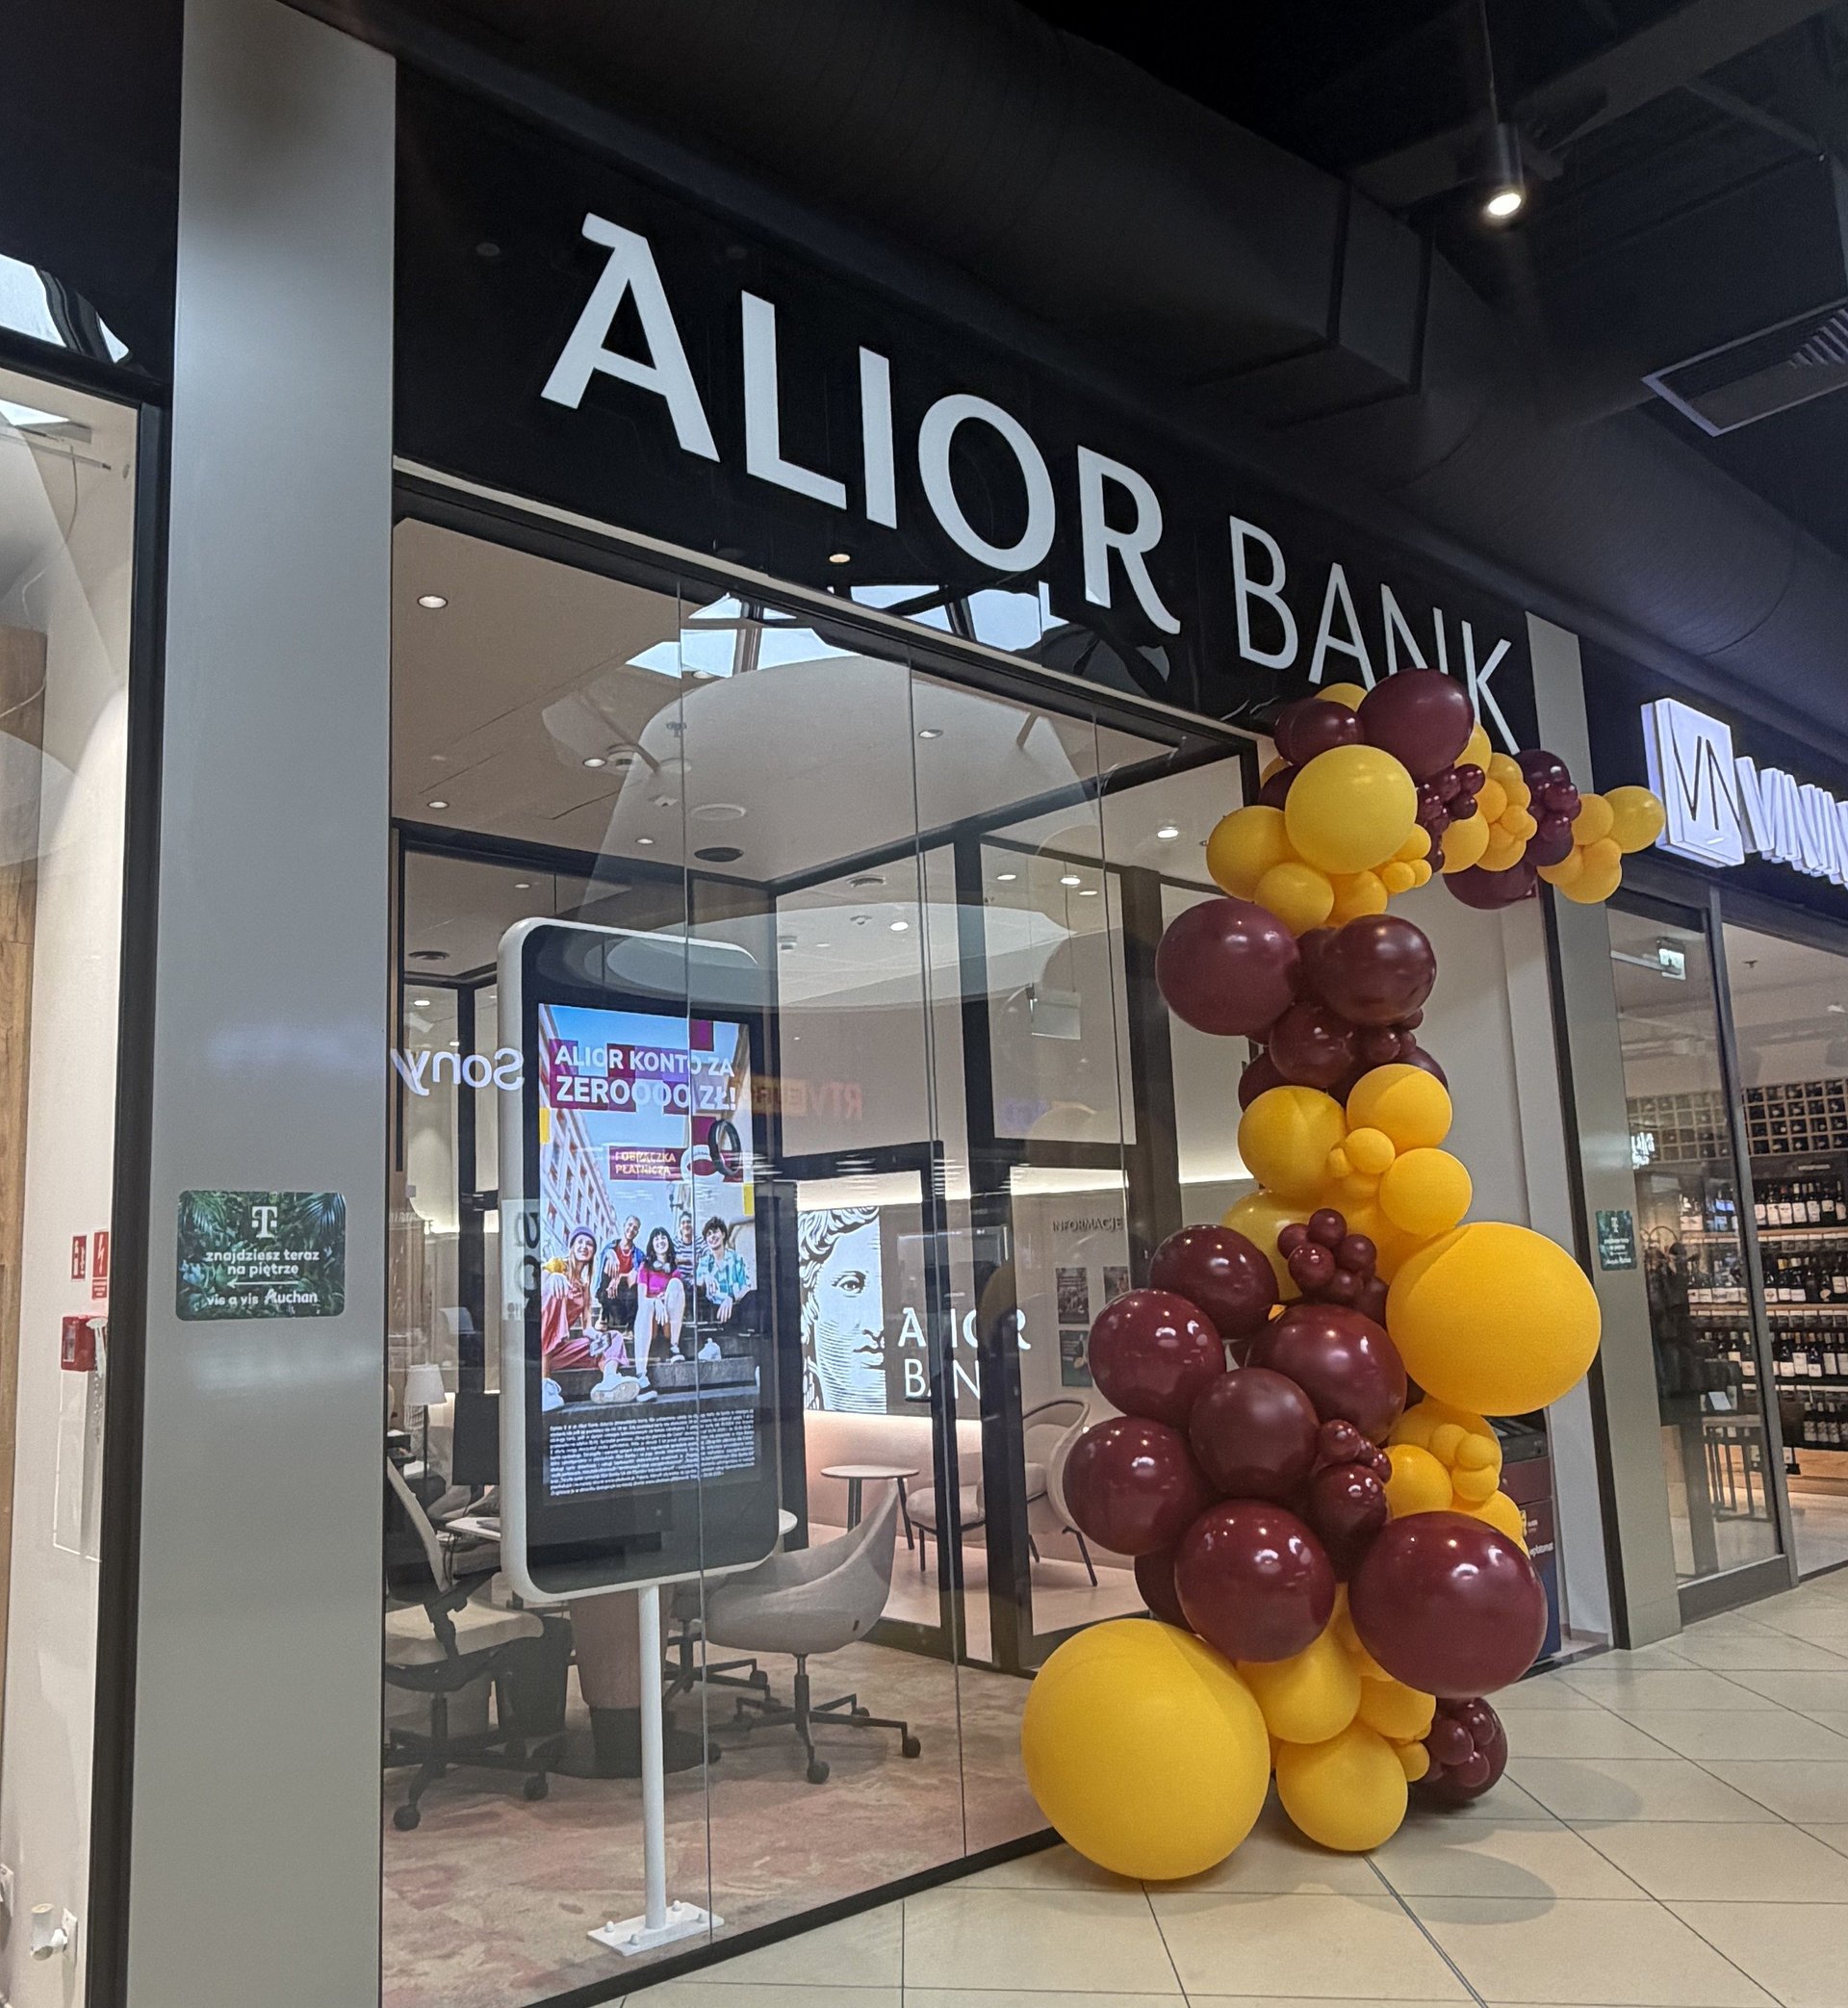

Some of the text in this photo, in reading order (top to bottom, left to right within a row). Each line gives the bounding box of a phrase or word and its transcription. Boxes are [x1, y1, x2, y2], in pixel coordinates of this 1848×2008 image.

[540, 212, 1521, 756] ALIOR BANK
[554, 1044, 735, 1077] ALIOR KONTO ZA
[556, 1075, 691, 1109] ZEROOOO
[700, 1085, 736, 1111] ZŁ!
[1053, 1217, 1124, 1232] INFORMACJE
[206, 1249, 321, 1264] znajdziesz teraz
[228, 1262, 299, 1278] na piętrze
[207, 1295, 226, 1306] vis
[241, 1293, 259, 1305] vis
[264, 1288, 319, 1305] Auchan
[897, 1307, 1032, 1350] AIR
